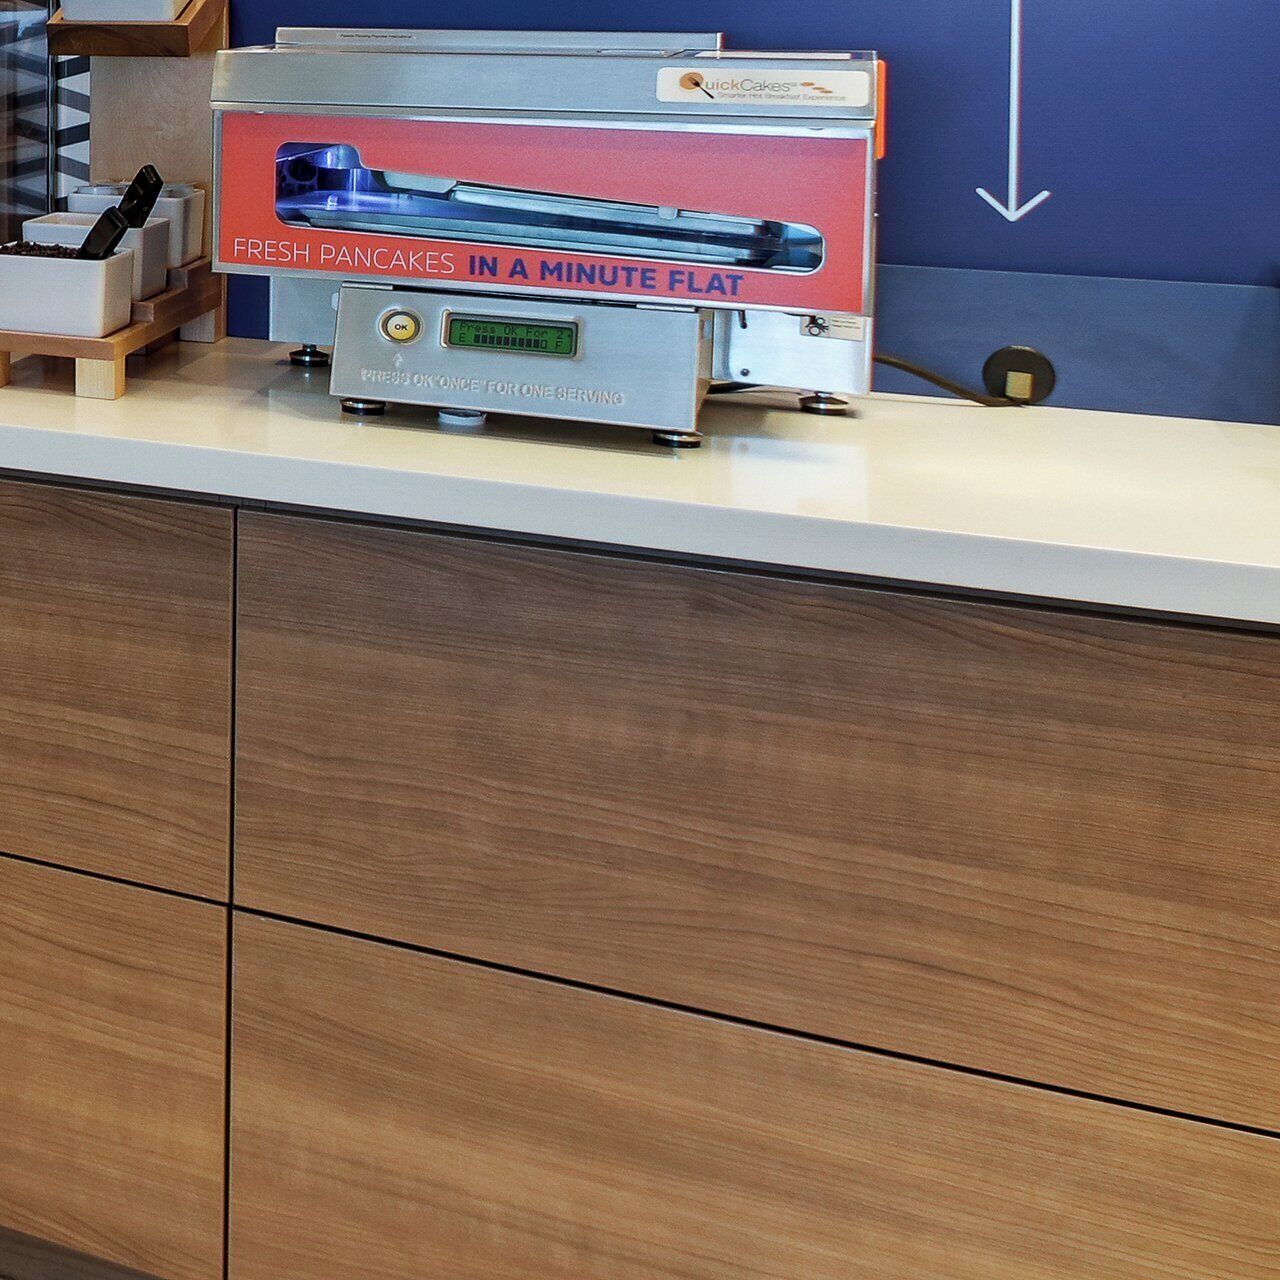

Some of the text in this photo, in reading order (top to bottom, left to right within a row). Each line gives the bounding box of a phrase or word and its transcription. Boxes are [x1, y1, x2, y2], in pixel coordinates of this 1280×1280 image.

[233, 238, 744, 296] FRESH PANCAKES IN A MINUTE FLAT
[459, 323, 496, 335] Press
[503, 325, 517, 335] OK
[526, 326, 550, 338] For
[360, 368, 410, 386] PRESS
[487, 380, 518, 396] FOR
[520, 384, 553, 399] ONE
[555, 387, 625, 406] SERVING
